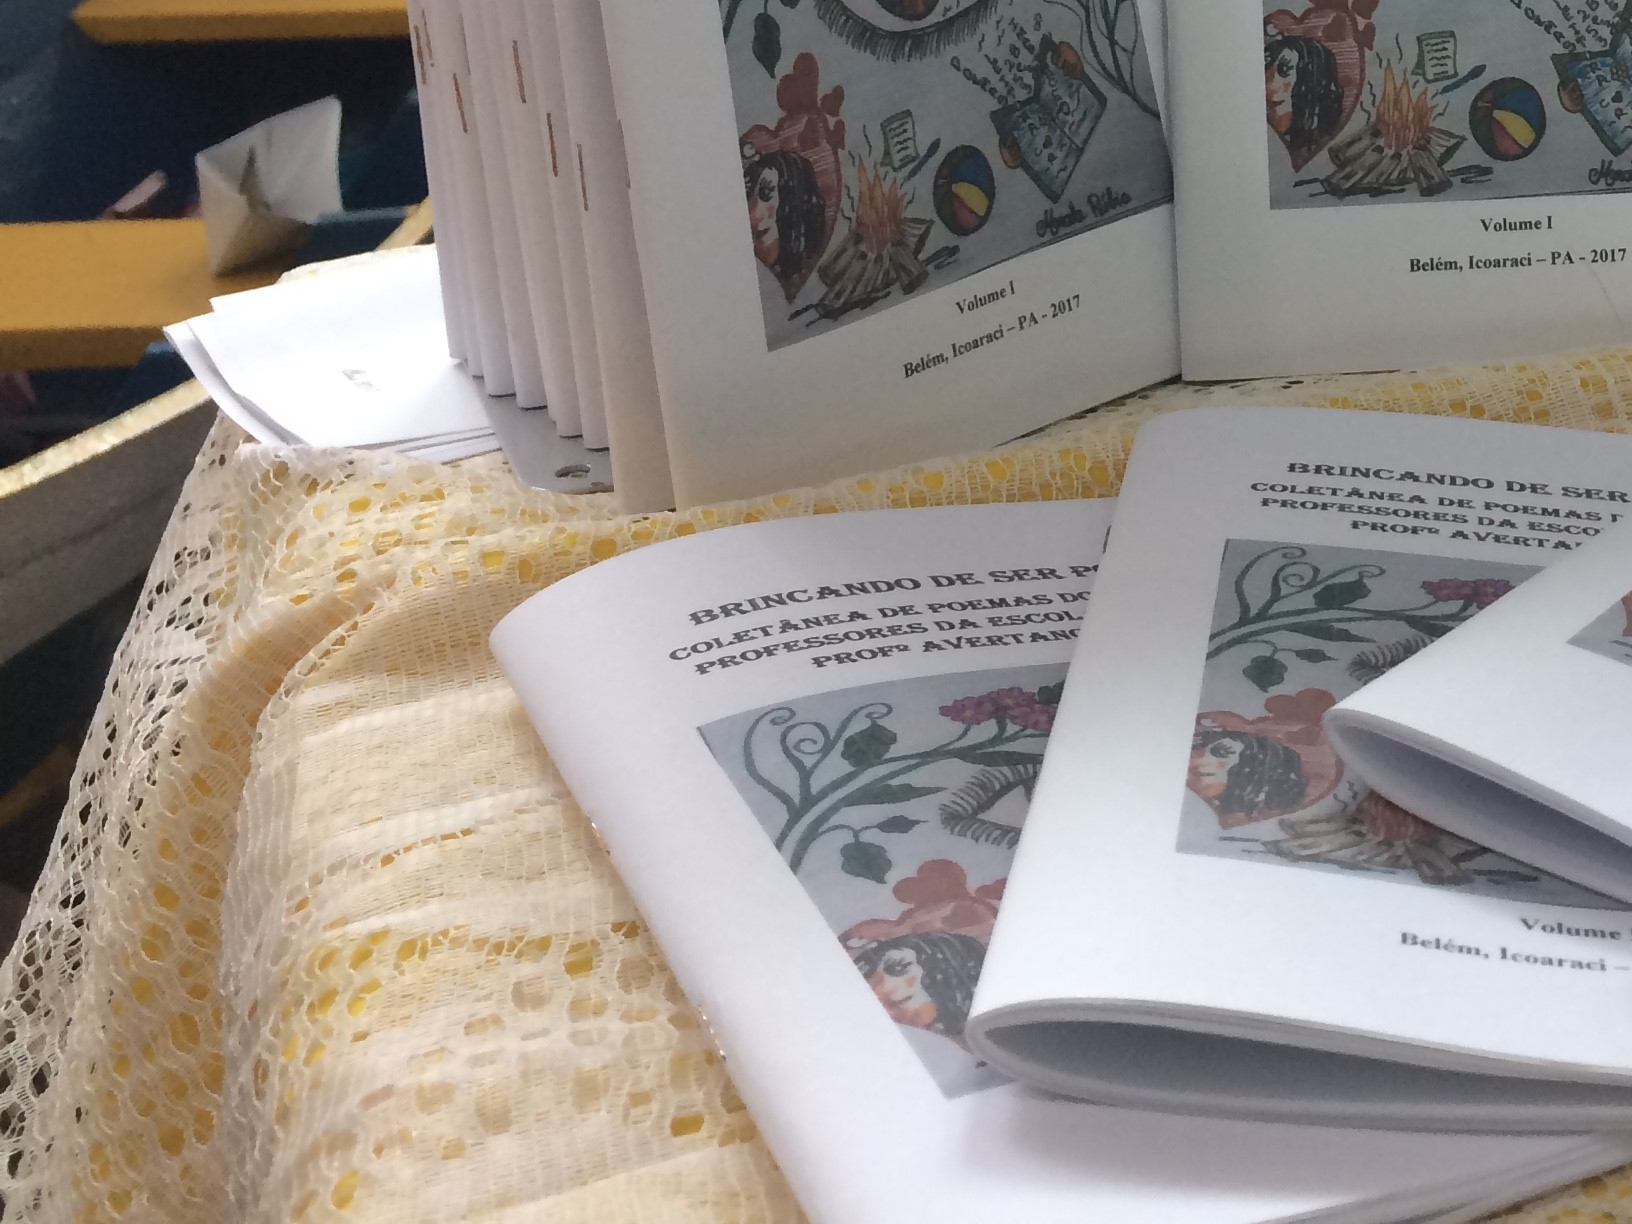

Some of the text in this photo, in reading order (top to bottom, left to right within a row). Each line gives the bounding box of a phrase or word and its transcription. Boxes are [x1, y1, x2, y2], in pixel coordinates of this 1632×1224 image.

[1480, 216, 1552, 232] Volume I
[1409, 248, 1626, 272] Belém, Icoaraci PA 2017
[955, 280, 1015, 314] Volume I
[903, 294, 1080, 378] Belém, Icoaraci PA 2017
[1251, 483, 1602, 521] COLETÂNEA DE POEMAS
[1287, 463, 1494, 489] BRINCANDO
[1506, 481, 1552, 495] DE
[1561, 487, 1631, 503] SER
[1260, 498, 1518, 529] PROFESSORES DA
[688, 568, 1060, 626] BRINCANDO DE SER
[669, 595, 1053, 660] COLETÂNEA DE POEMAS
[694, 619, 982, 675] PROFESSORES DA
[1520, 918, 1622, 940] Volume
[1400, 931, 1490, 960] Belém,
[1499, 946, 1607, 972] Icoaraci
